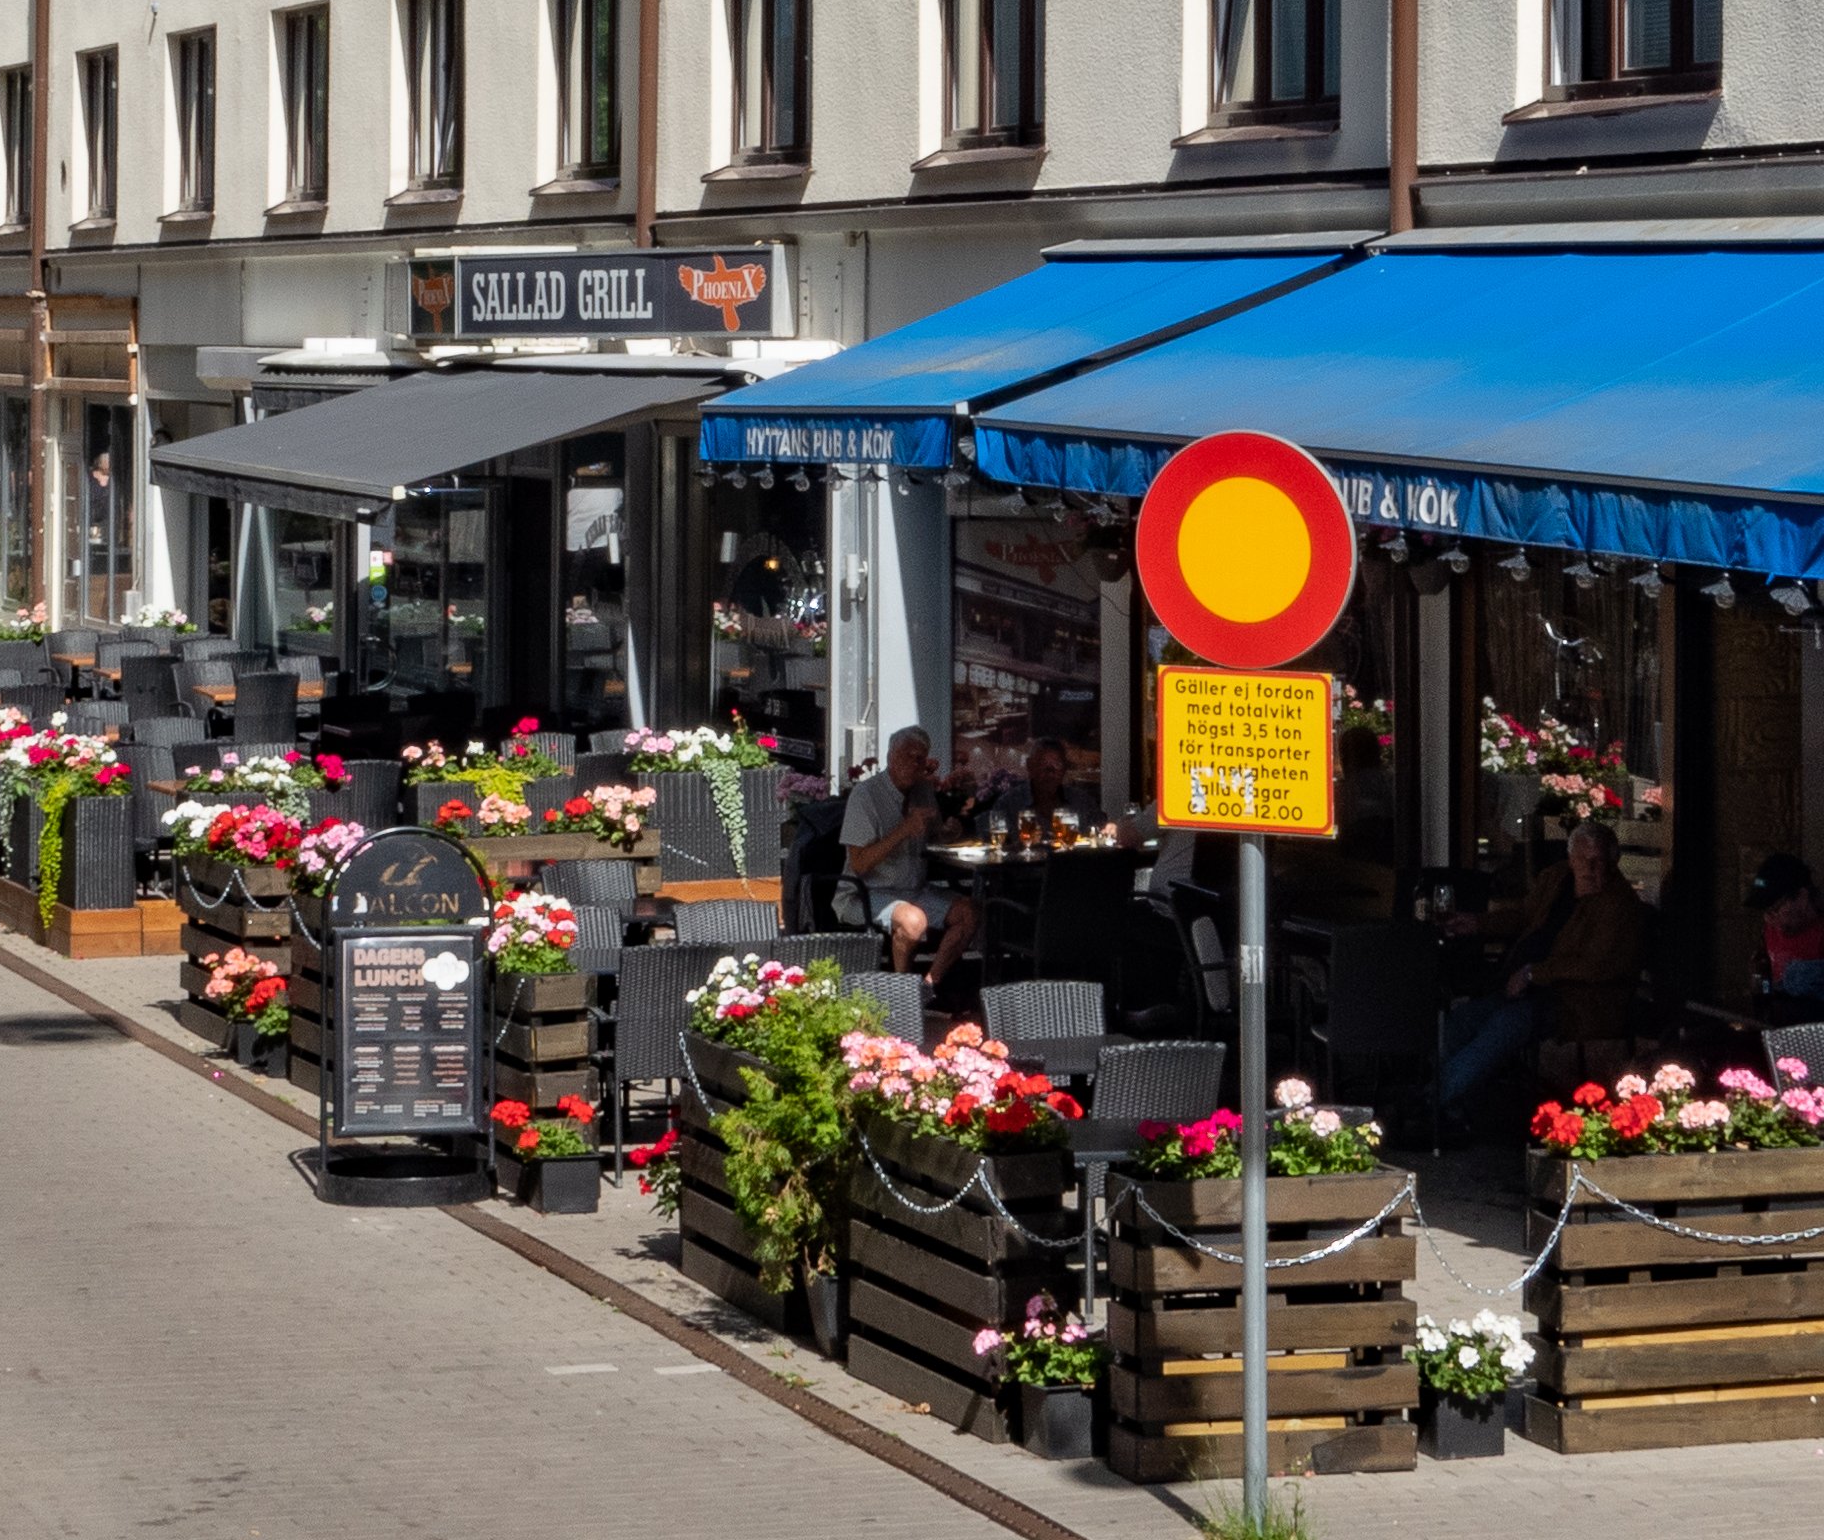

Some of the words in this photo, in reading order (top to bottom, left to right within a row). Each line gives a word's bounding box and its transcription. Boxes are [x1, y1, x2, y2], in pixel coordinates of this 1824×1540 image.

[472, 270, 566, 322] SALLAD
[578, 268, 653, 320] GRILL
[692, 266, 757, 301] PHOENIX
[746, 427, 809, 457] HYTTANS
[813, 429, 843, 458] PUB
[847, 430, 856, 458] &
[861, 423, 894, 459] KÖK
[1334, 478, 1373, 516] UB
[1379, 482, 1399, 520] &
[1175, 679, 1227, 696] Gäller
[1234, 682, 1250, 700] ej
[1257, 683, 1314, 700] fordon
[1187, 702, 1222, 715] med
[1229, 703, 1302, 720] totalvikt
[1188, 720, 1234, 739] högst
[1243, 723, 1268, 741] 3,5
[1275, 726, 1301, 740] ton
[1179, 739, 1203, 754] för
[1211, 742, 1310, 761] transporter
[1210, 761, 1309, 782] fastgheten
[354, 892, 460, 915] ALCON
[354, 947, 426, 966] DAGENS
[354, 968, 425, 987] LUNCH
